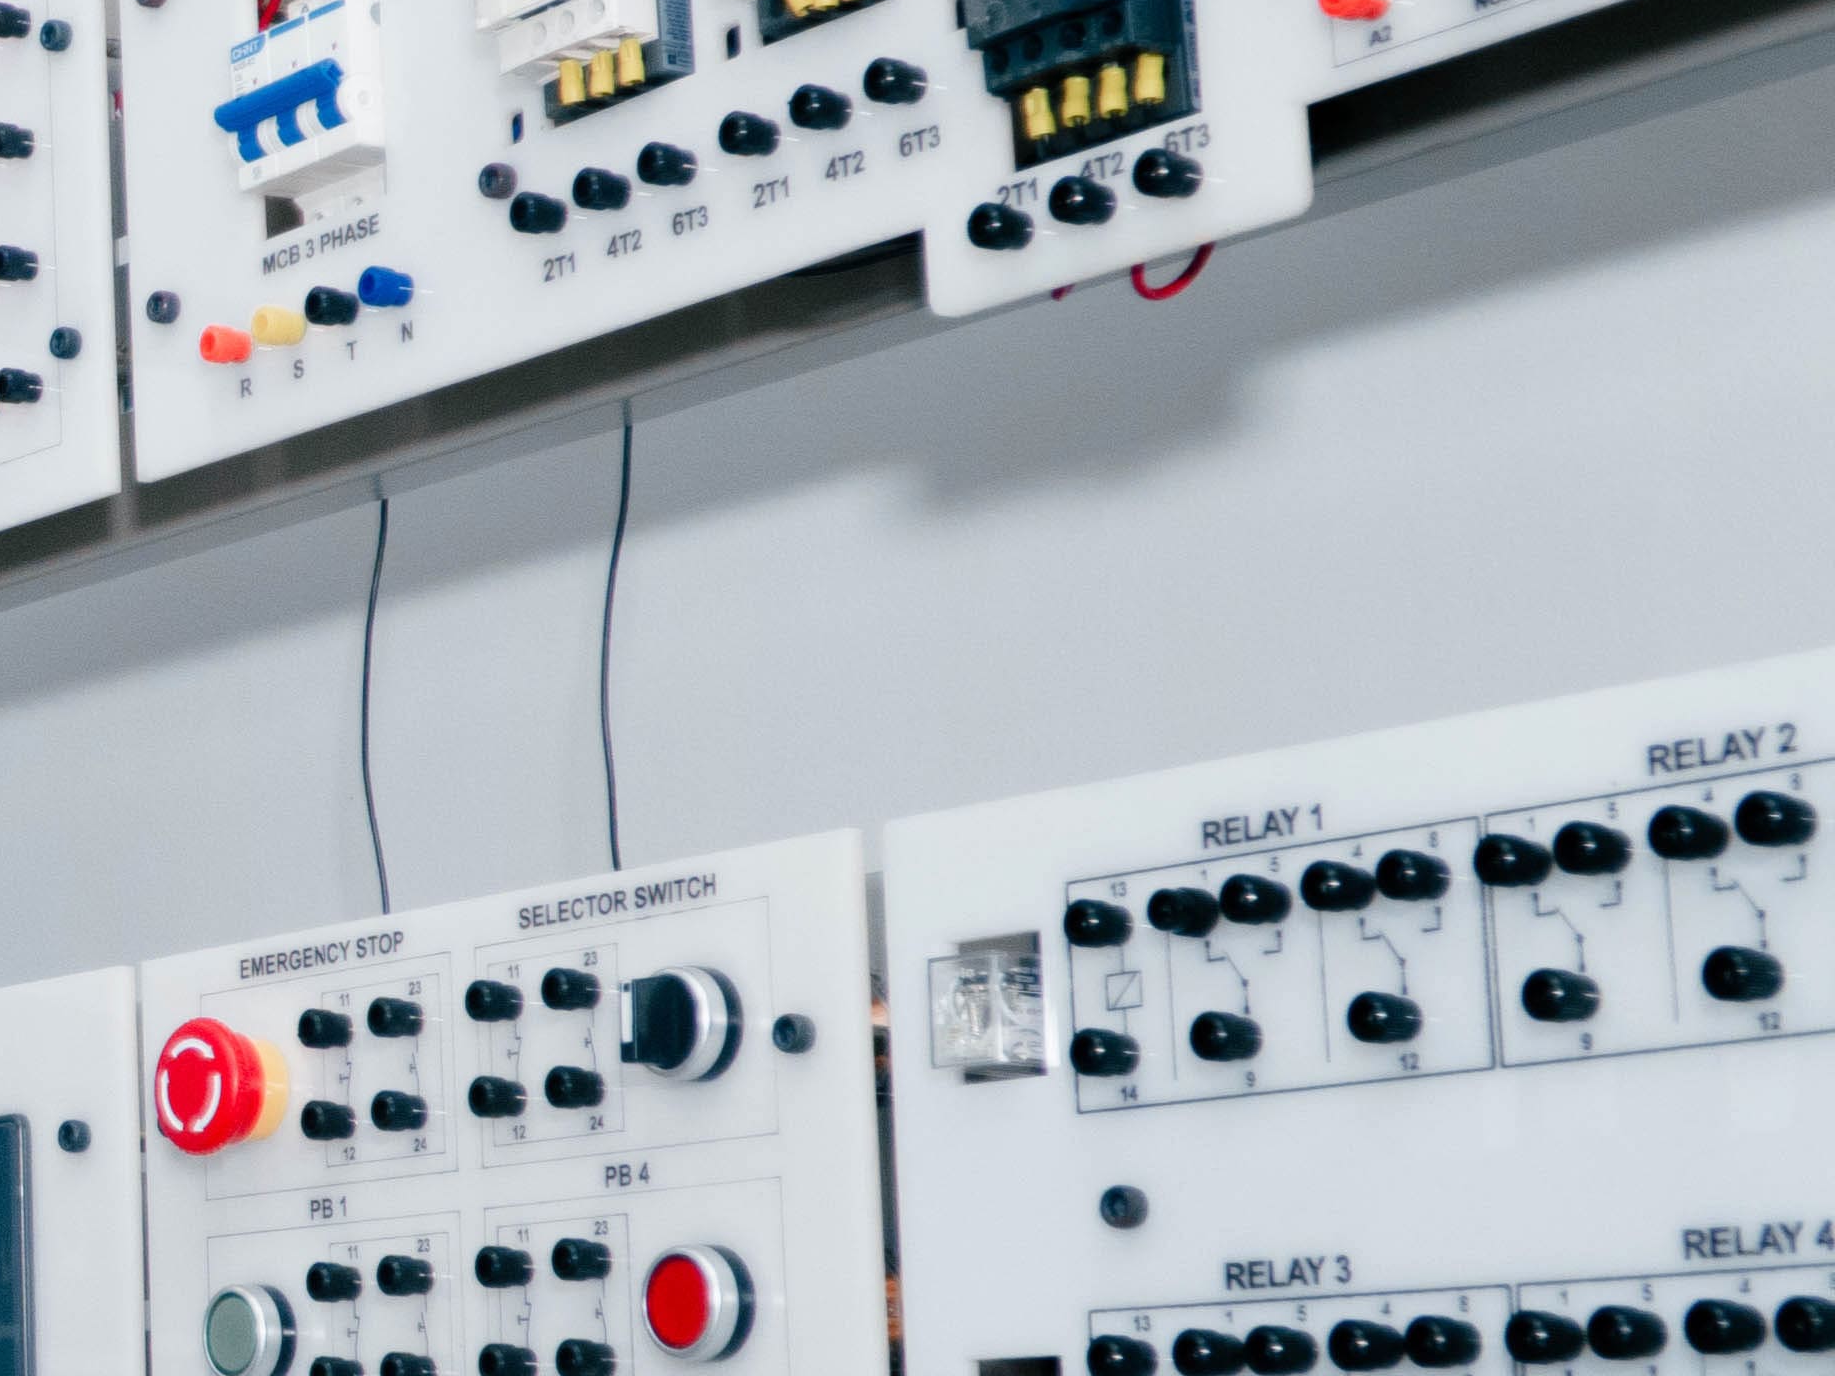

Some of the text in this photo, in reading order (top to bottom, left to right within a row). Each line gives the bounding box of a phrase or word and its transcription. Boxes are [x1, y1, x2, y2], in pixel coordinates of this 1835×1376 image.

[754, 126, 940, 207] 2T1 4T2 6T3
[1081, 152, 1123, 183] 4T2
[1166, 124, 1210, 152] 6T3
[262, 214, 380, 274] MCB 3 PHASE
[543, 205, 709, 282] 2T1 4T2 6T3
[241, 322, 412, 397] R S T N
[1648, 723, 1797, 775] RELAY 2
[1202, 805, 1322, 849] RELAY 1
[519, 874, 717, 930] SELECTOR SWITCH
[240, 932, 404, 979] EMERGENCY STOP
[605, 1163, 649, 1187] PB 4
[310, 1198, 347, 1220] PB 1
[1684, 1220, 1835, 1259] RELAY 4
[1226, 1256, 1352, 1290] RELAY 3
